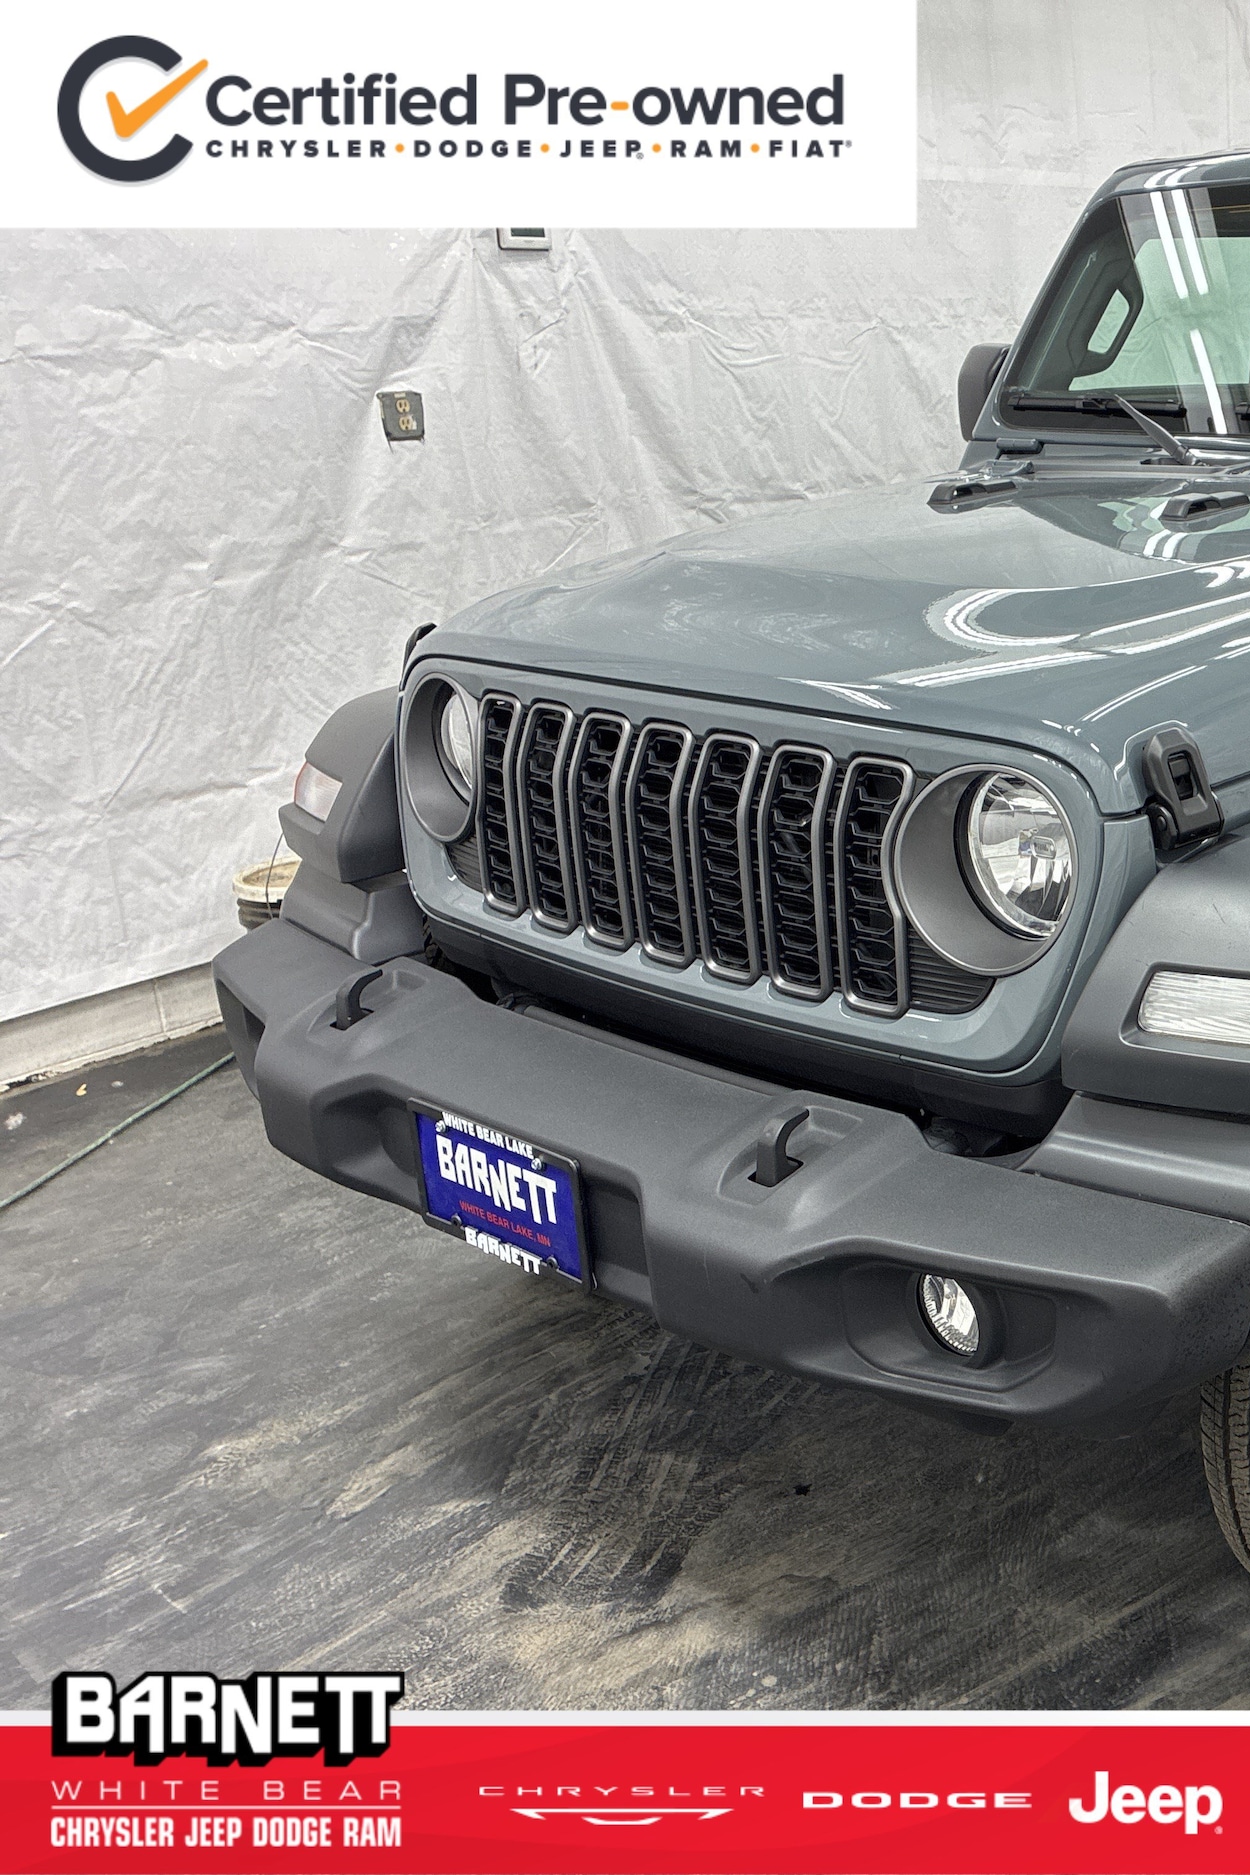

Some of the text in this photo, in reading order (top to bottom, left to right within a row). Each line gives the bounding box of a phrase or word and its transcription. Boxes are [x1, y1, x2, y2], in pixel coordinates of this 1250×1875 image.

[442, 1111, 535, 1160] WHITE BEAR LAKE
[436, 1133, 557, 1225] BARNETT
[459, 1200, 486, 1218] WHITE
[487, 1211, 510, 1230] BEAR
[536, 1232, 552, 1247] MN
[465, 1225, 542, 1275] BARNETT
